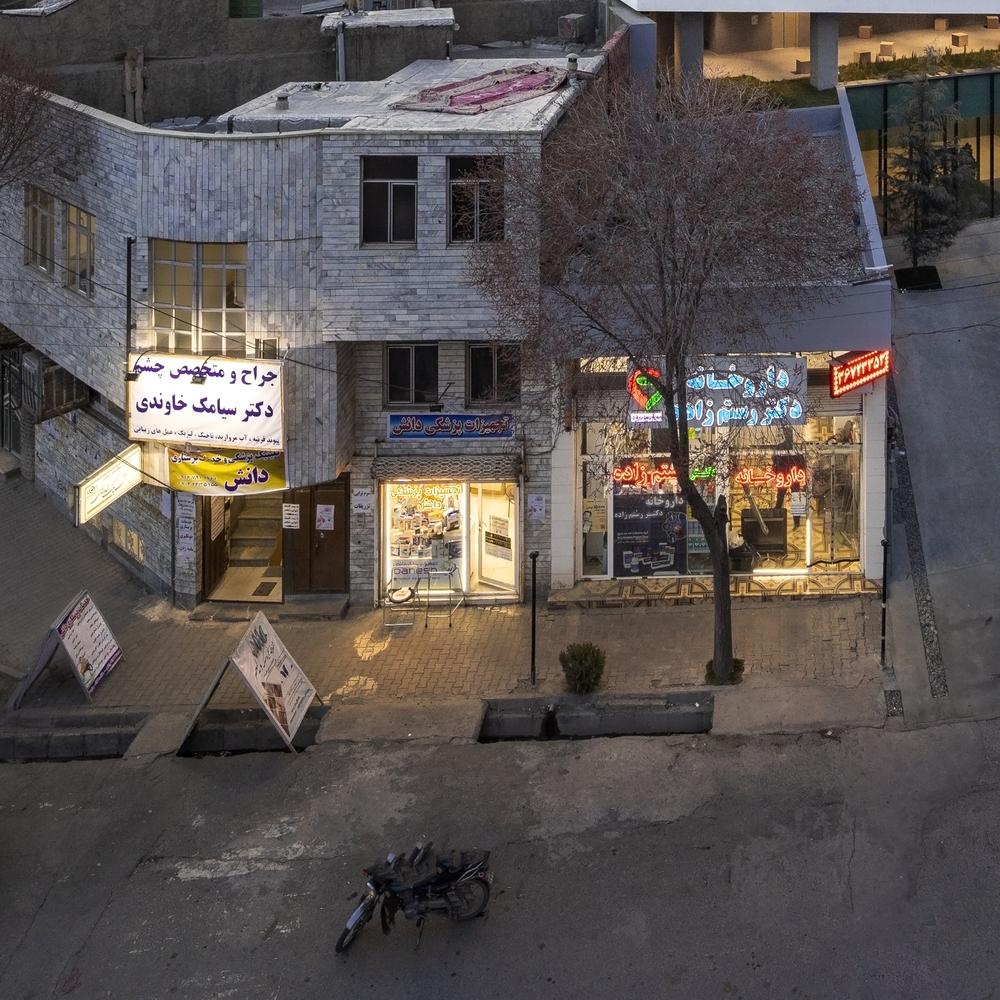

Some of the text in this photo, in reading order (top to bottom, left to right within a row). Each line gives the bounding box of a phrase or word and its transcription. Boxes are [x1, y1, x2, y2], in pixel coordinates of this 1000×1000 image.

[134, 357, 278, 387] جراح و متخصص چشم
[686, 363, 789, 398] داروخانه
[136, 393, 274, 422] دکتر سیامک خاوندی
[717, 399, 758, 427] رستم
[760, 397, 803, 426] دکتر
[392, 416, 510, 436] تجهیزات پزشکی دانش
[171, 451, 198, 464] پرستاری
[228, 451, 254, 464] پزشکی
[224, 466, 269, 491] دانش
[613, 461, 648, 486] زاده
[735, 466, 806, 488] داروخانه
[390, 484, 462, 500] تجهیزات پزشکی
[645, 495, 684, 508] داروخانه
[416, 497, 442, 511] دانش
[645, 509, 664, 519] دکتر
